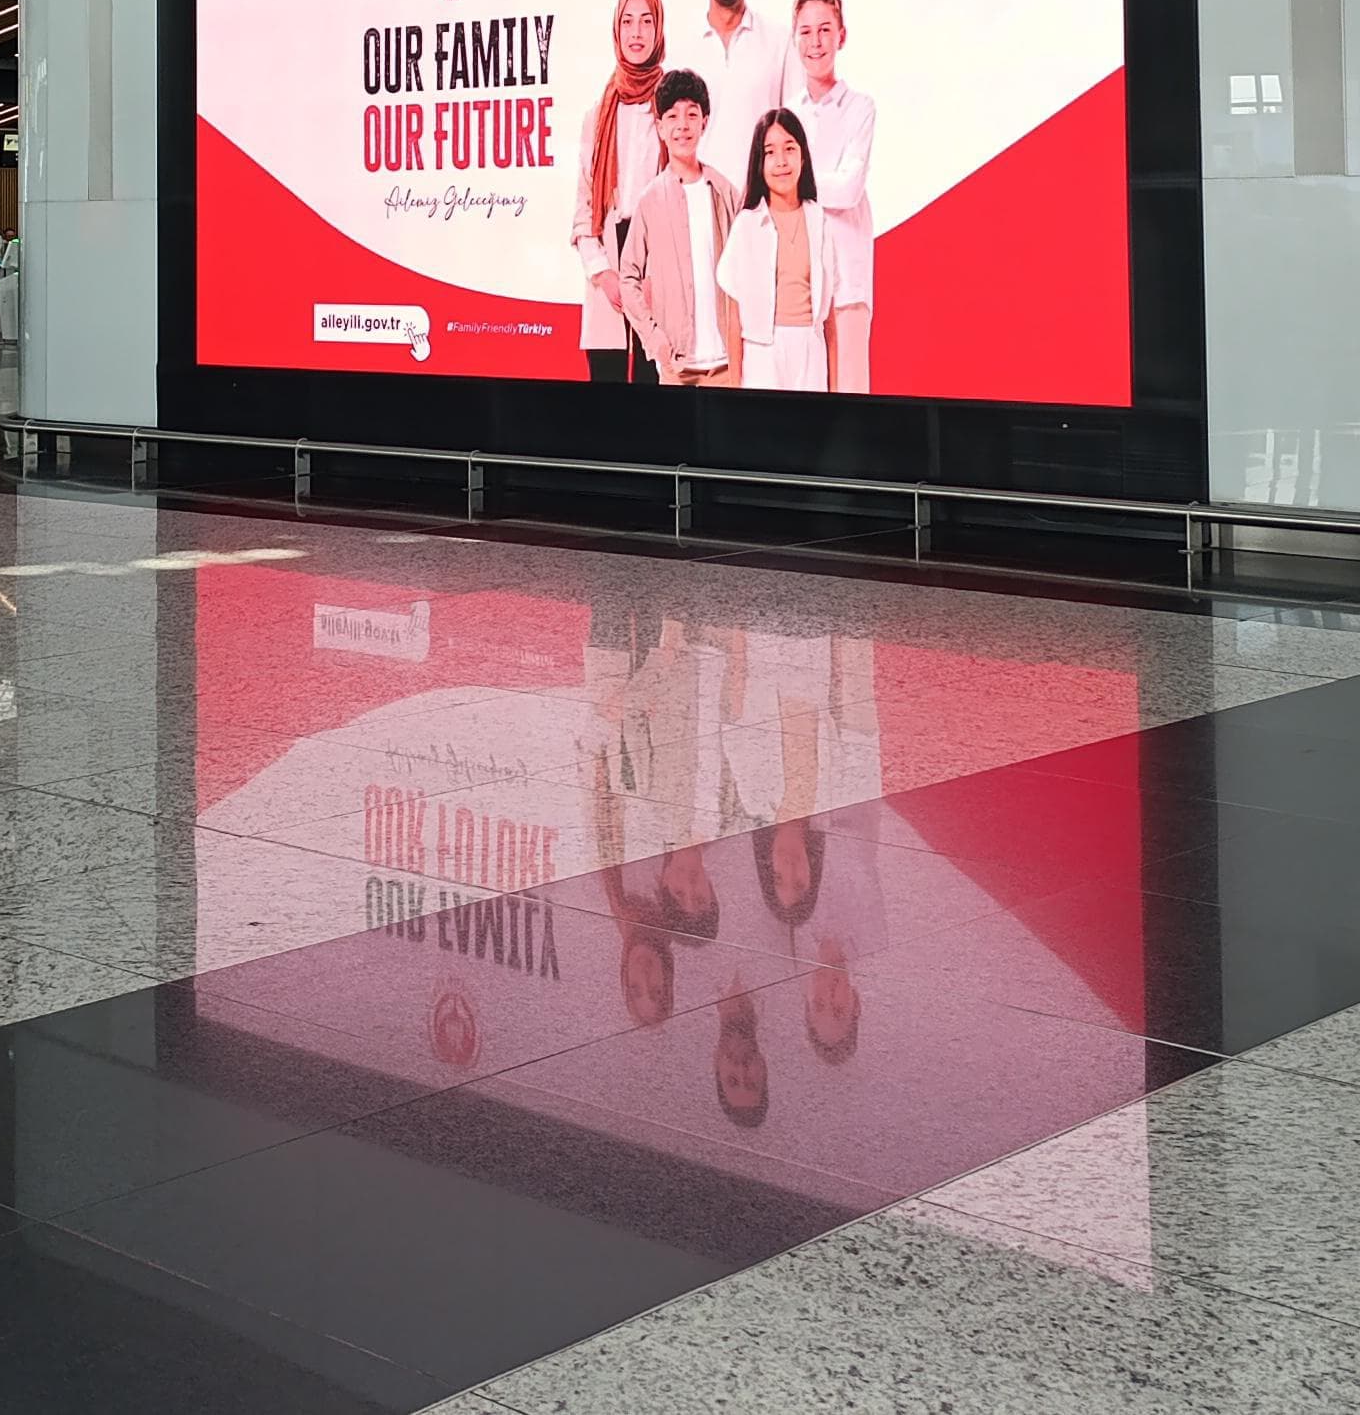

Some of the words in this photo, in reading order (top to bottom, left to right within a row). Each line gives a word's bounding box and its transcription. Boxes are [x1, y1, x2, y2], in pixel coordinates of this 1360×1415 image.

[363, 25, 424, 95] OUR
[435, 14, 554, 91] FAMILY
[363, 103, 424, 172] OUR
[434, 97, 554, 170] FUTURE
